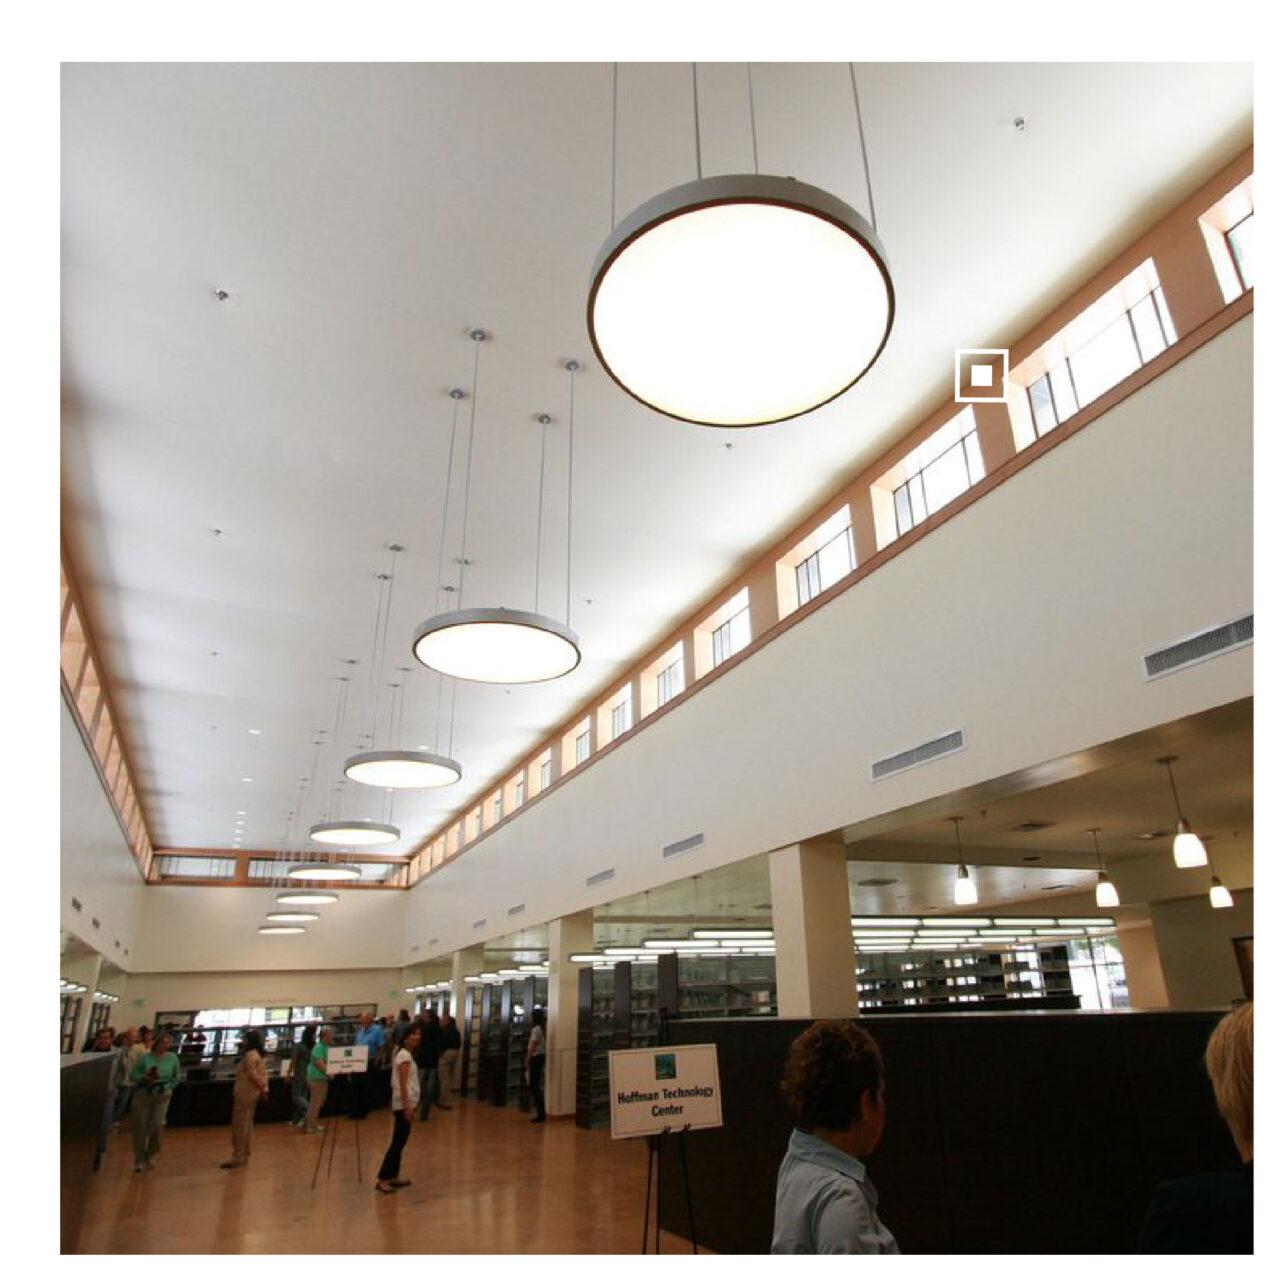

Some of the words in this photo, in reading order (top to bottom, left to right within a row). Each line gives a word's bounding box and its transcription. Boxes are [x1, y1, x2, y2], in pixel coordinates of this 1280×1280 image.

[618, 1091, 659, 1104] Hoffman
[662, 1086, 713, 1099] Technology
[652, 1105, 683, 1116] Center
